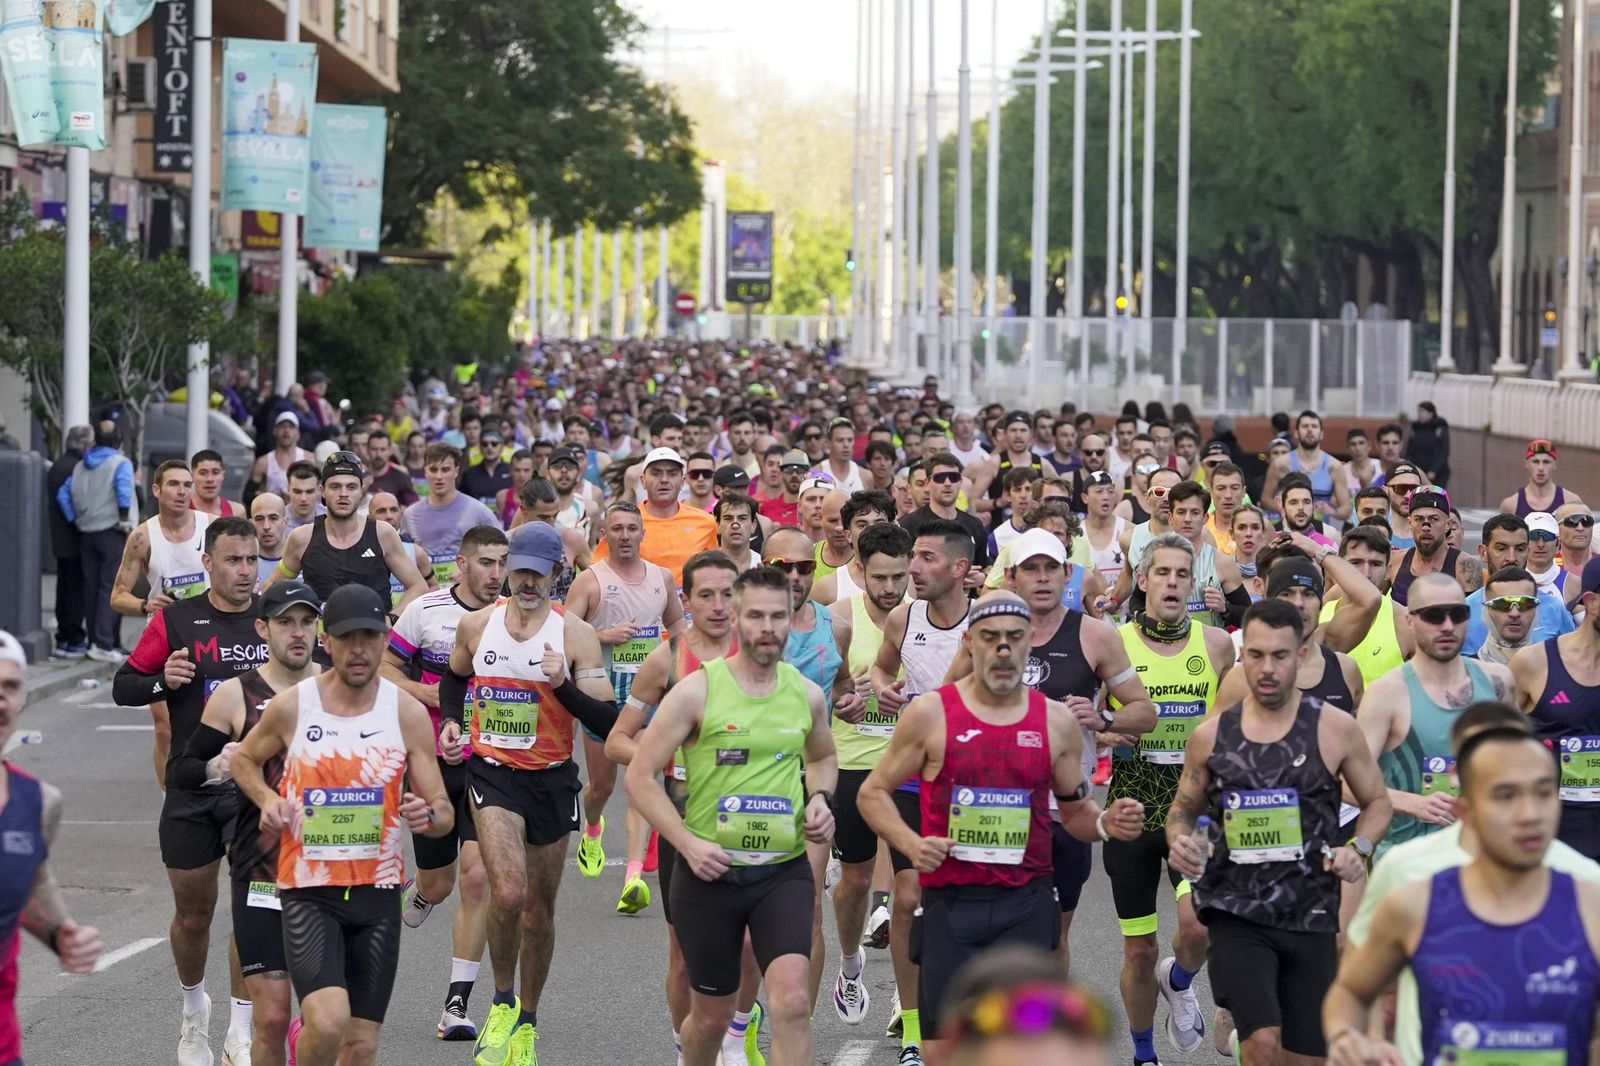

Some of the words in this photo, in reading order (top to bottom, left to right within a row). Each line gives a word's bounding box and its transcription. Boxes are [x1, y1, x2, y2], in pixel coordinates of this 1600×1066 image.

[495, 690, 532, 700] ZURICH
[1144, 681, 1210, 700] PORTEMANIA
[496, 708, 514, 718] 1605
[1164, 702, 1200, 715] ZURICH
[1165, 723, 1185, 733] 2473
[1140, 739, 1166, 750] INMA
[1168, 739, 1175, 750] Y
[1561, 777, 1588, 787] LOREN
[330, 792, 375, 803] ZURICH
[978, 793, 1023, 804] ZURICH
[1244, 794, 1289, 806] ZURICH
[745, 799, 787, 811] ZURICH
[331, 813, 355, 824] 2267
[978, 815, 1002, 825] 2071
[1246, 816, 1270, 828] 2637
[746, 821, 769, 831] 1982
[303, 833, 330, 845] PAPA
[332, 833, 346, 845] DE
[348, 832, 381, 844] ISABEL
[741, 835, 771, 849] GUY
[1240, 830, 1281, 847] MAWI
[250, 882, 275, 894] ANGE
[1484, 1029, 1554, 1047] ZURICH
